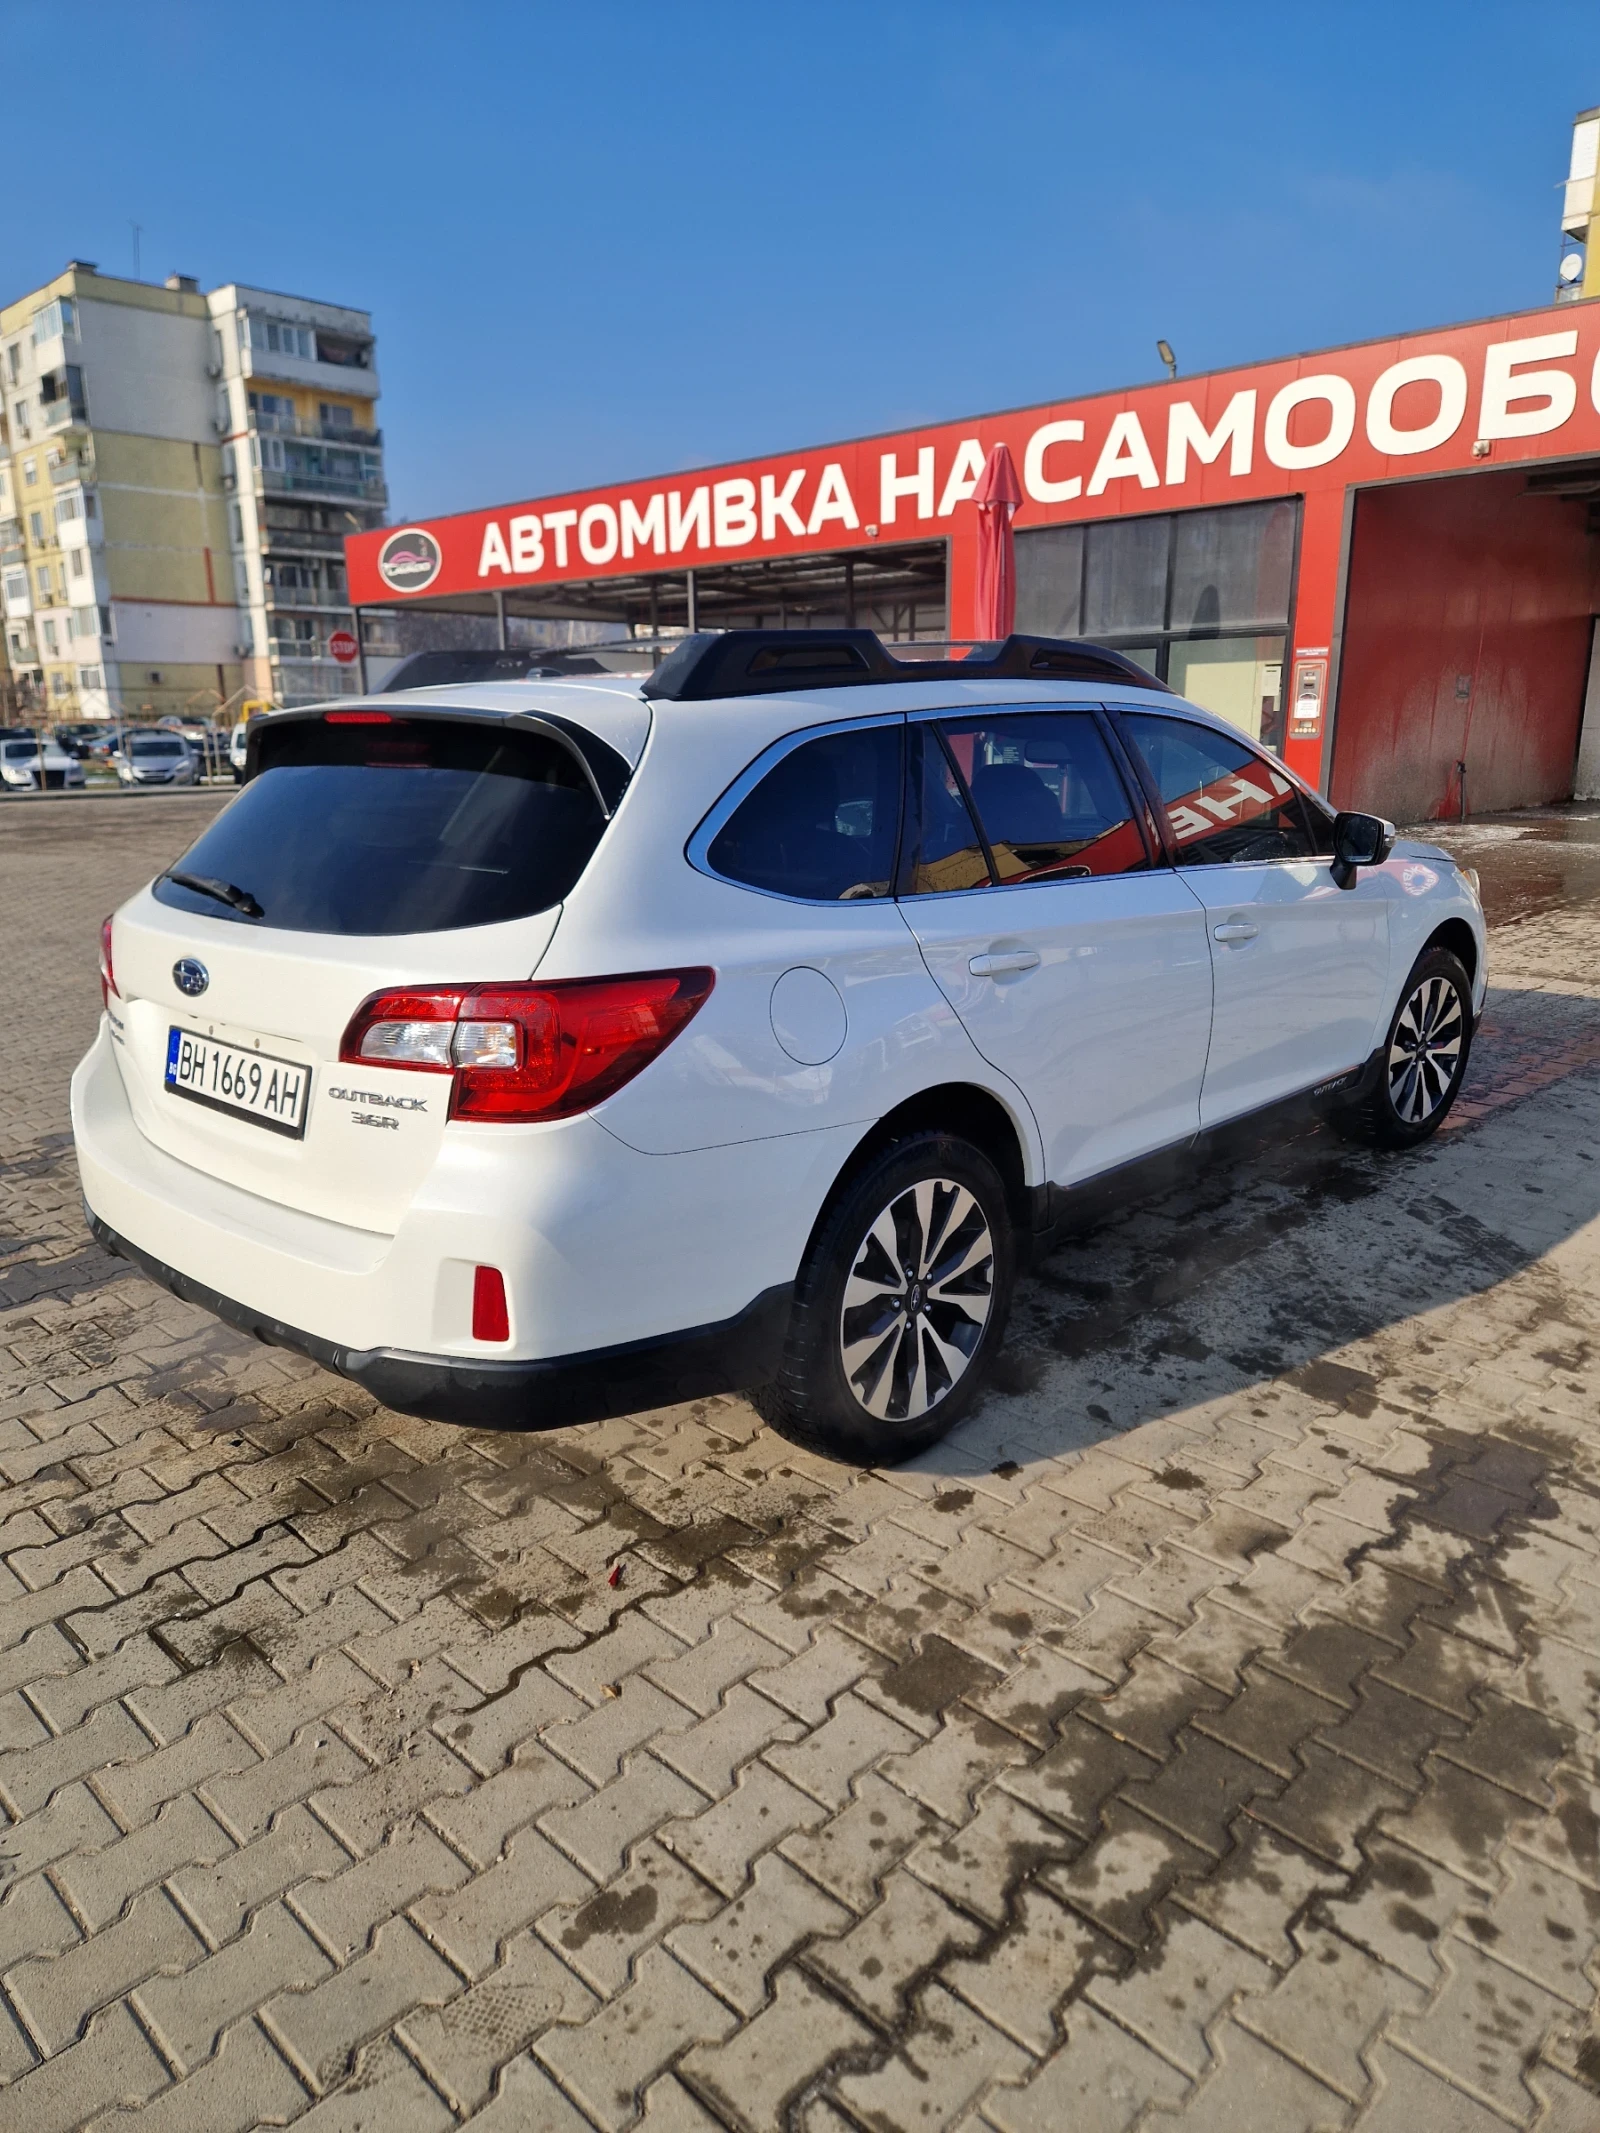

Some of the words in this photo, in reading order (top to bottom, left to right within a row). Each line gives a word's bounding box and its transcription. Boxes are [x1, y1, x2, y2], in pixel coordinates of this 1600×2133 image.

[478, 463, 860, 577] АВТОМИВКА
[880, 439, 988, 525] НА
[1024, 330, 1600, 503] САМООБ
[331, 640, 357, 655] STOP
[179, 1040, 207, 1087] BH
[212, 1050, 262, 1105] 1669
[264, 1068, 300, 1119] AH
[328, 1087, 429, 1113] OUTBACK
